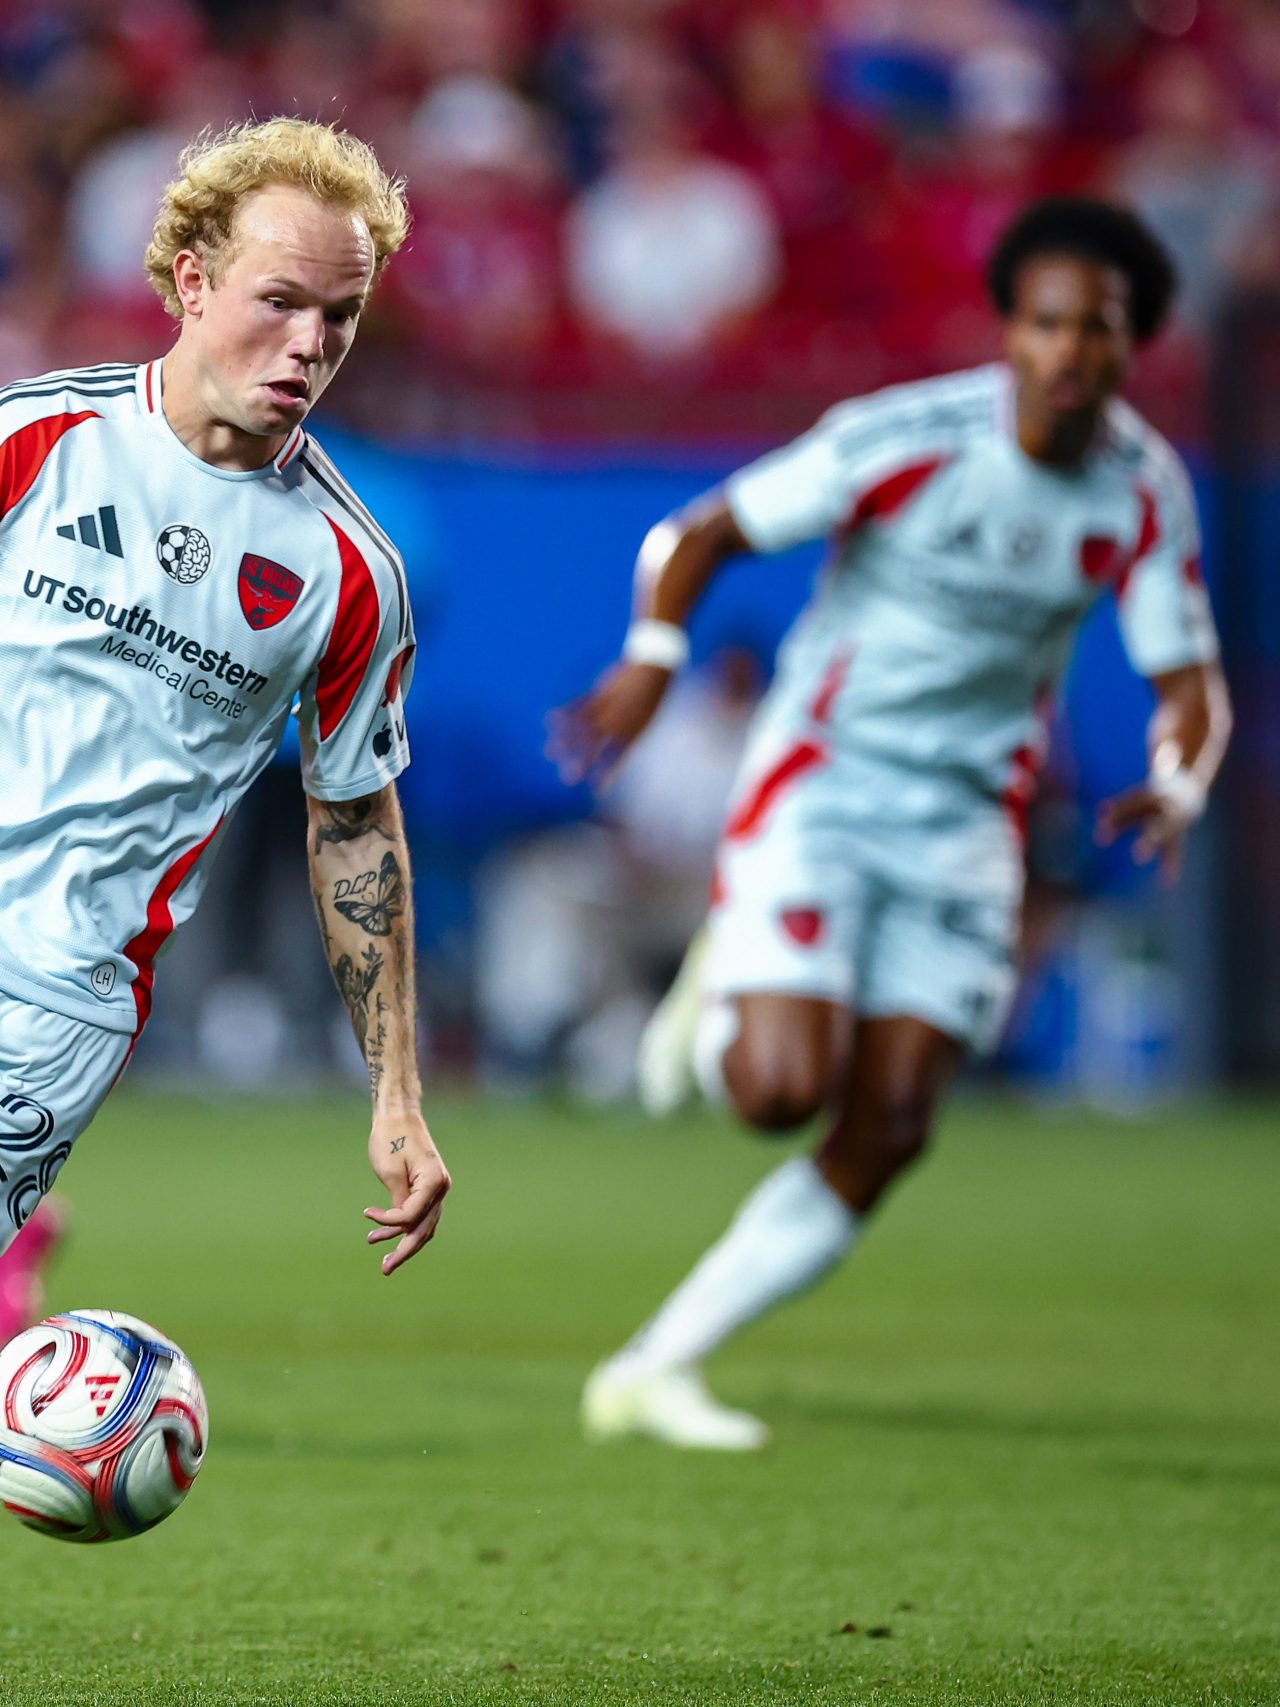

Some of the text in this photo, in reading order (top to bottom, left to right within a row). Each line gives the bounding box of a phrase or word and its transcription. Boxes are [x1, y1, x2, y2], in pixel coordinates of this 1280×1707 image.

[99, 635, 248, 720] Medical Center
[333, 870, 378, 900] DLP
[95, 969, 112, 987] LH
